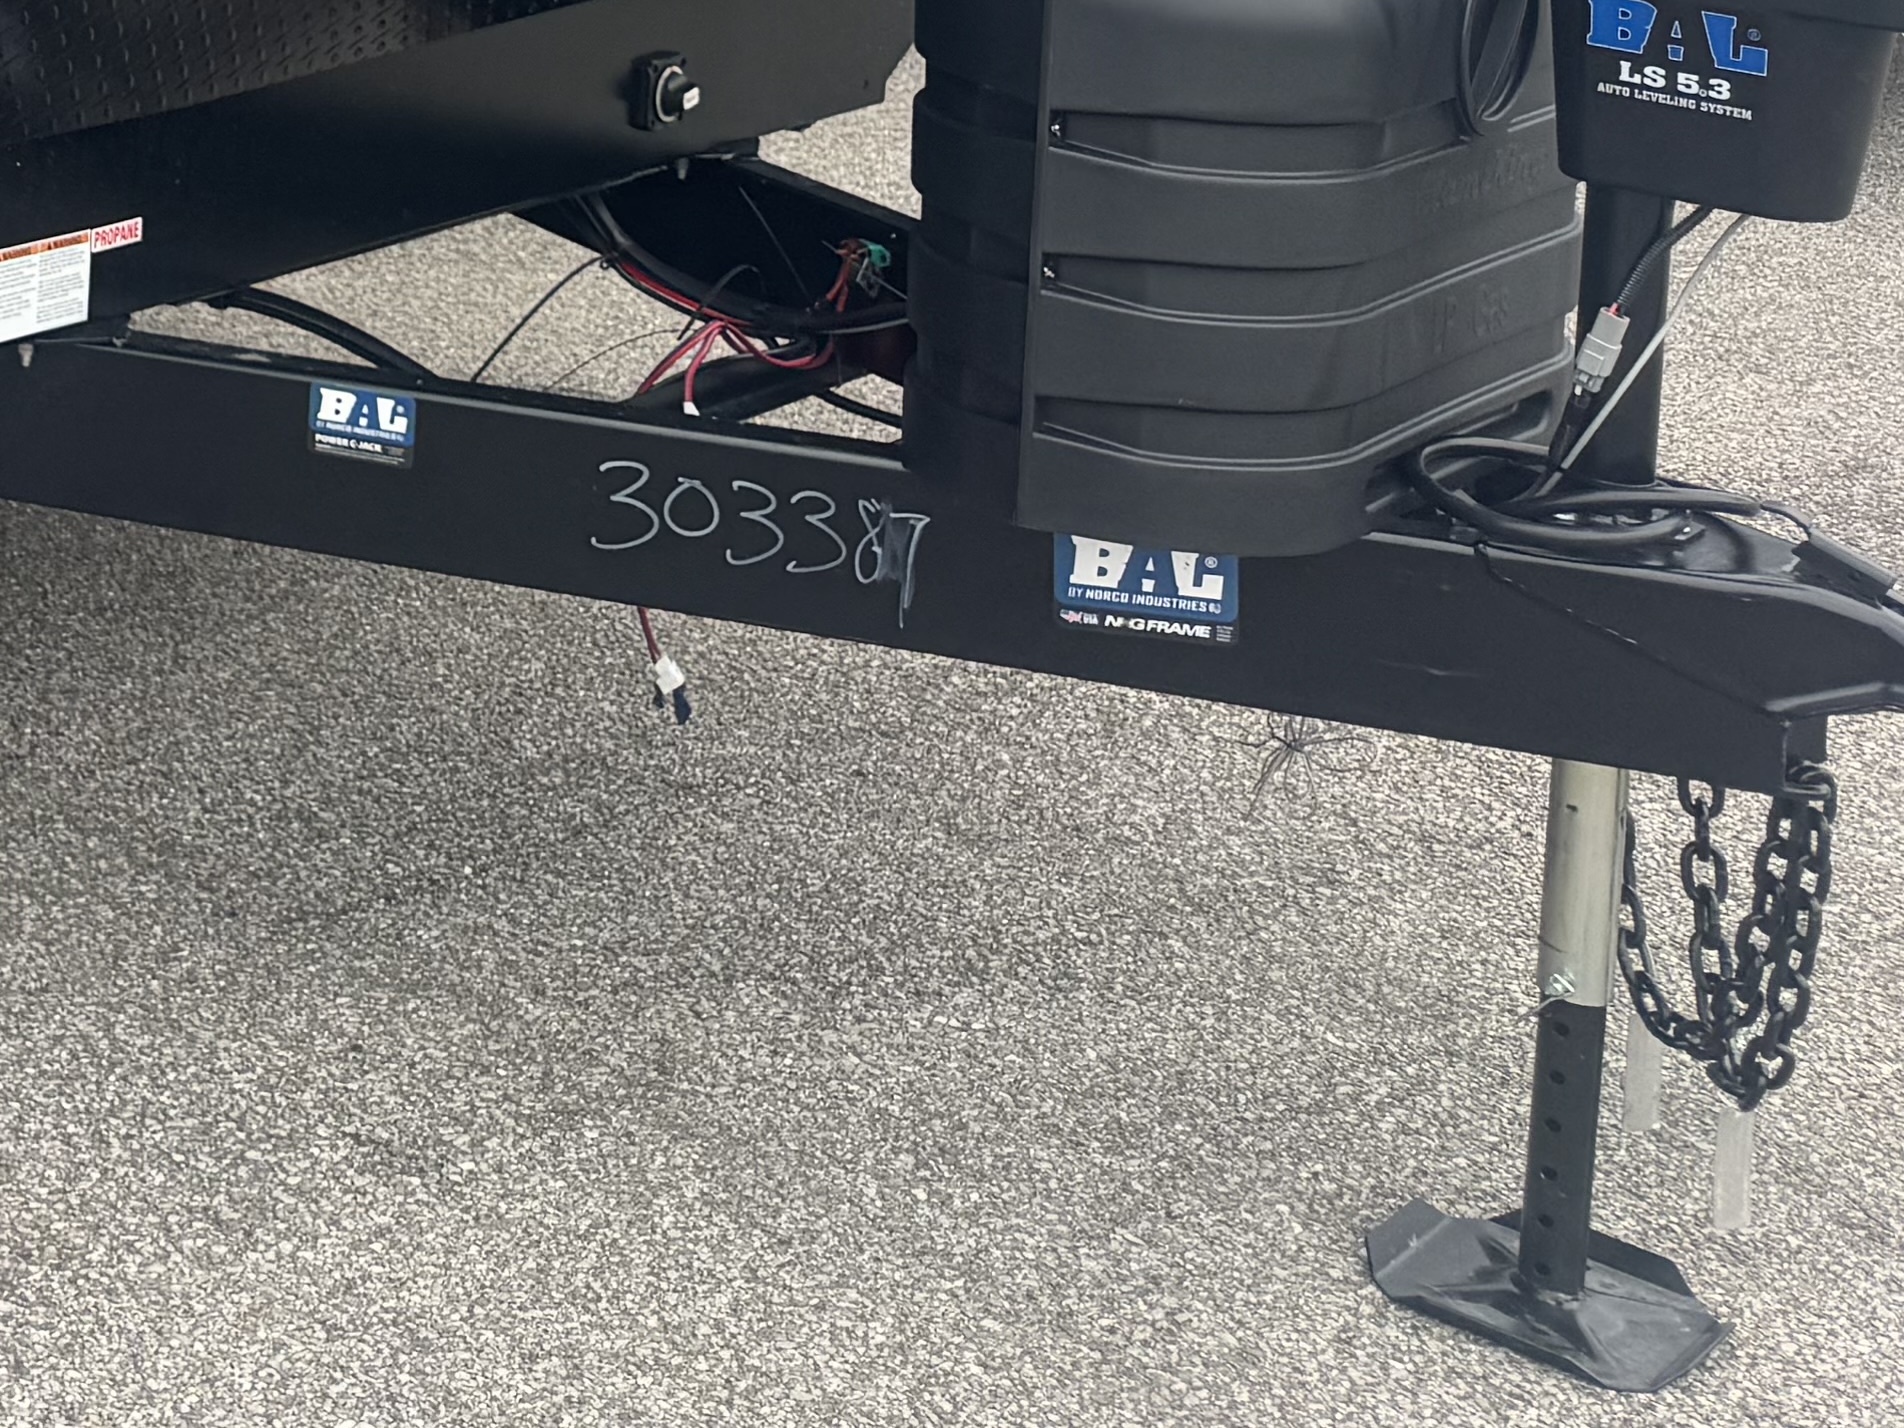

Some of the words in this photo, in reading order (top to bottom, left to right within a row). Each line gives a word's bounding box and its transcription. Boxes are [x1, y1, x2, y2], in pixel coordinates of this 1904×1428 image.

[1619, 60, 1667, 89] LS
[1677, 72, 1732, 101] 5.3
[1597, 82, 1630, 97] AUTO
[1634, 89, 1697, 110] LEVELING
[1700, 102, 1753, 121] SYSTEM
[93, 221, 140, 249] PROPANE
[317, 387, 409, 434] BAL
[1069, 535, 1224, 600] BAL
[1068, 586, 1082, 597] BY
[1085, 588, 1129, 603] NORCO
[1132, 594, 1208, 612] INDUSTRIES
